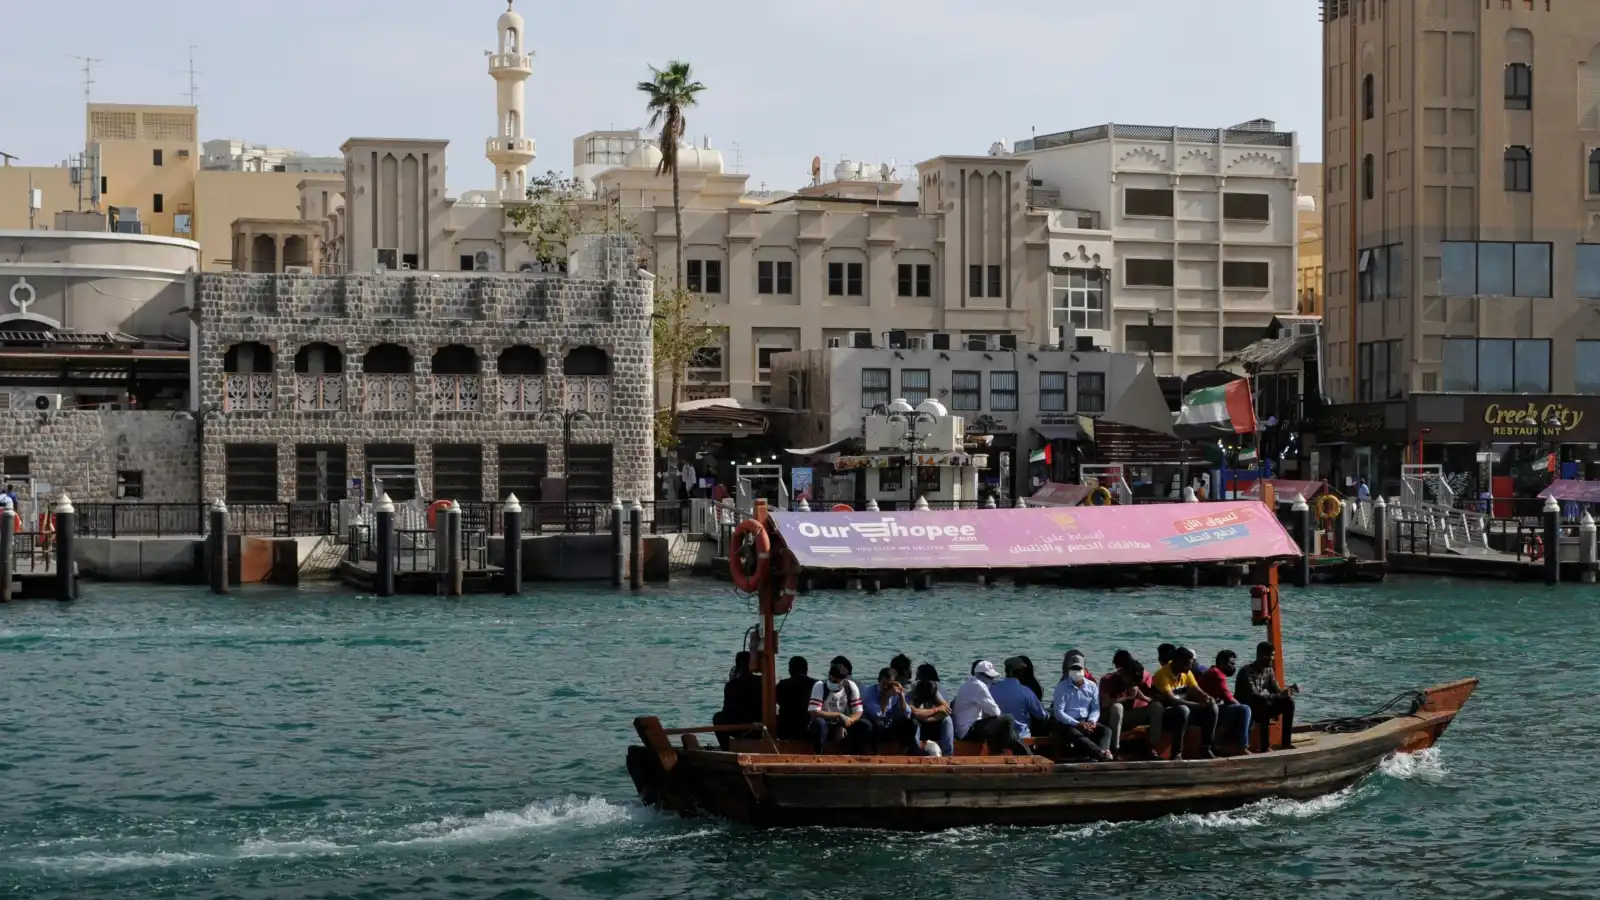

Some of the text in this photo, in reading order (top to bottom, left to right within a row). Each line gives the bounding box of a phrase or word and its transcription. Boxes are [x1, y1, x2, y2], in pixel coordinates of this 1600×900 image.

[1484, 402, 1584, 431] Creek City
[1206, 511, 1238, 527] تسوق
